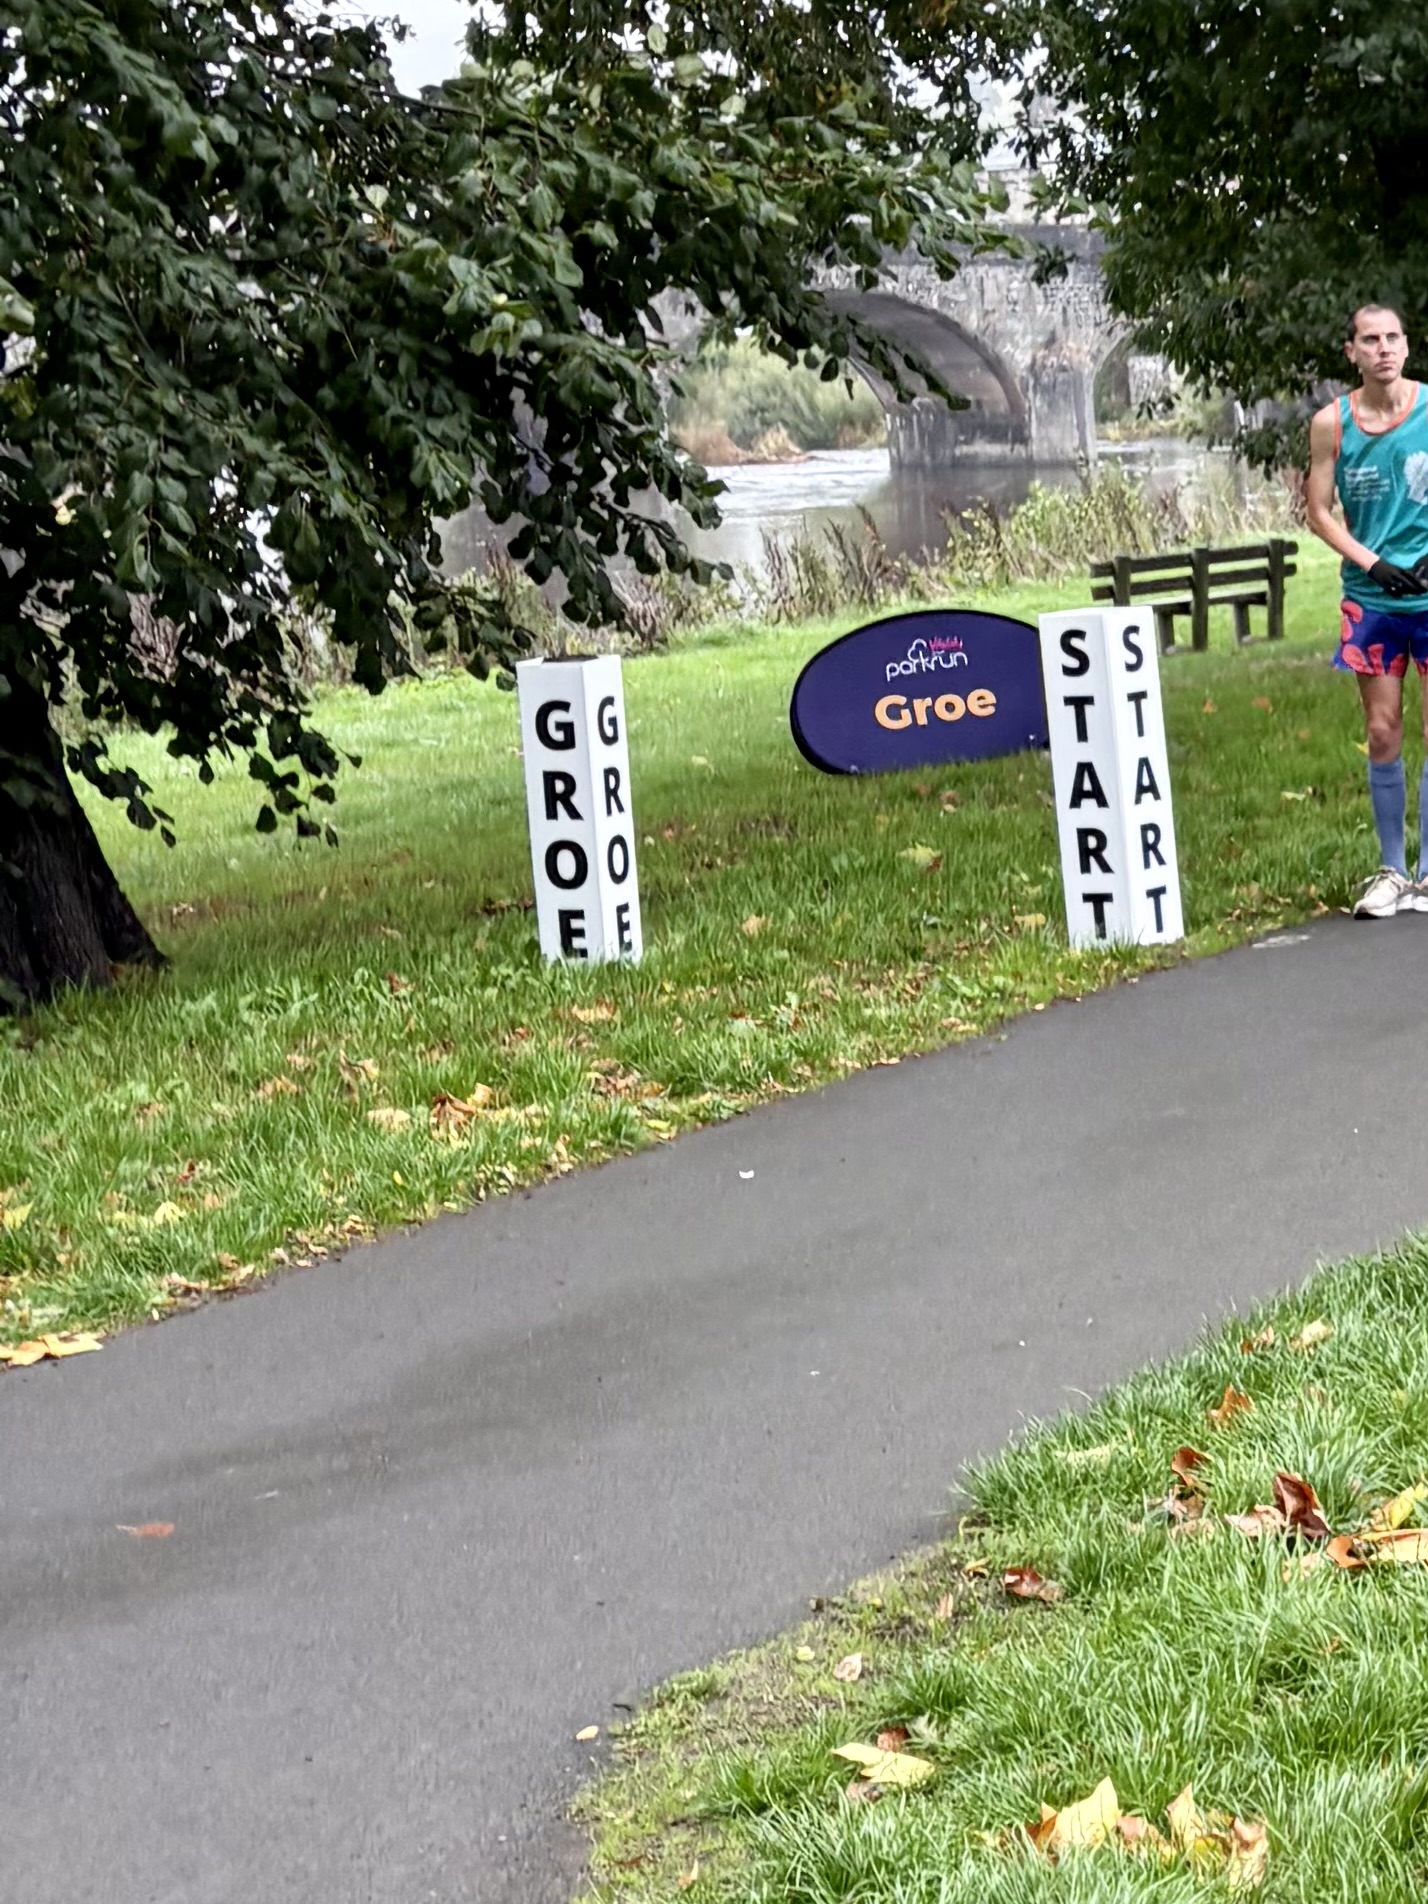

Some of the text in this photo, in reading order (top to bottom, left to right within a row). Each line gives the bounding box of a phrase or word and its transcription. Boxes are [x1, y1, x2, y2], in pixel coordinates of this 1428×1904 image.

[874, 688, 997, 730] Groe
[886, 645, 968, 682] parkrun
[1060, 629, 1114, 939] START
[1122, 625, 1167, 933] START
[535, 700, 588, 958] GROE
[597, 696, 633, 952] GROE
